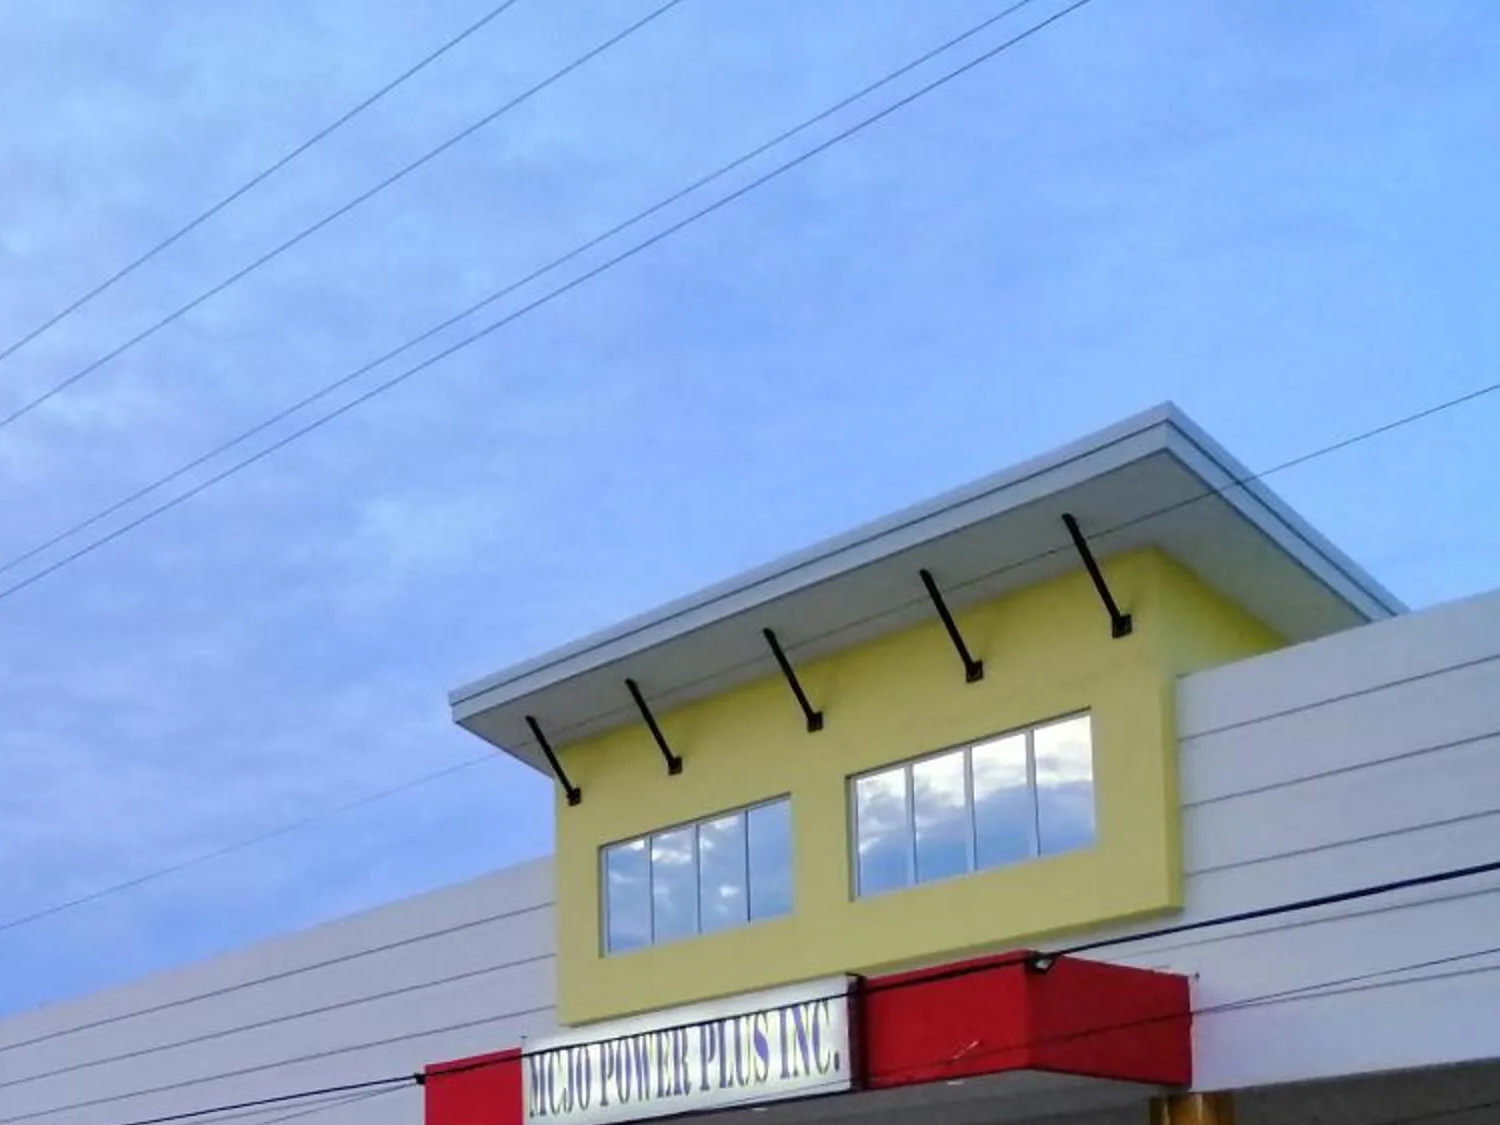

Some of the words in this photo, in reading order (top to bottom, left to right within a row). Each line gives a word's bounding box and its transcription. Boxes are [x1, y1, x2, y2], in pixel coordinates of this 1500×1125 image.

[600, 1027, 692, 1108] POWER
[699, 1009, 772, 1091] PLUS
[780, 998, 841, 1080] INC.
